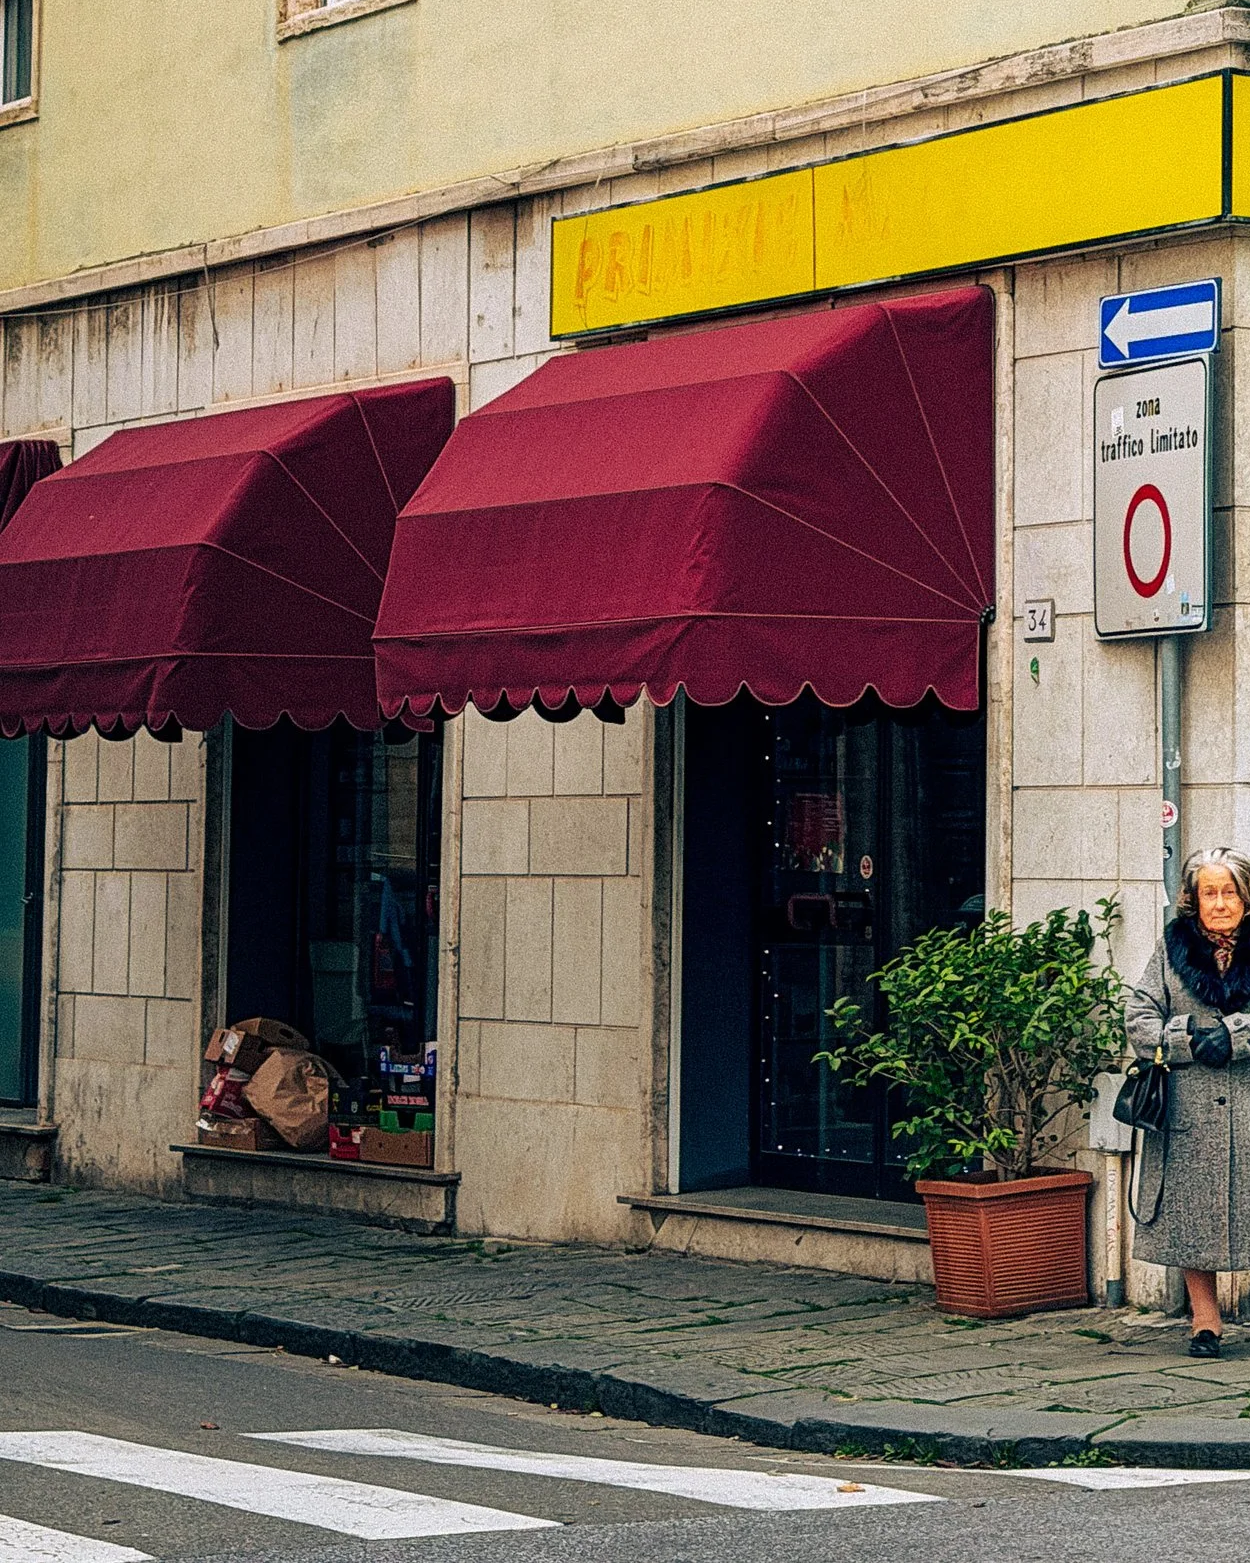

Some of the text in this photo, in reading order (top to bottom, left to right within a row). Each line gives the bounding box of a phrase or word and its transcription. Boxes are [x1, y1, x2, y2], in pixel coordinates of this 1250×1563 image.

[1136, 397, 1160, 419] zona
[1101, 435, 1144, 463] traffico
[1028, 609, 1047, 631] 34
